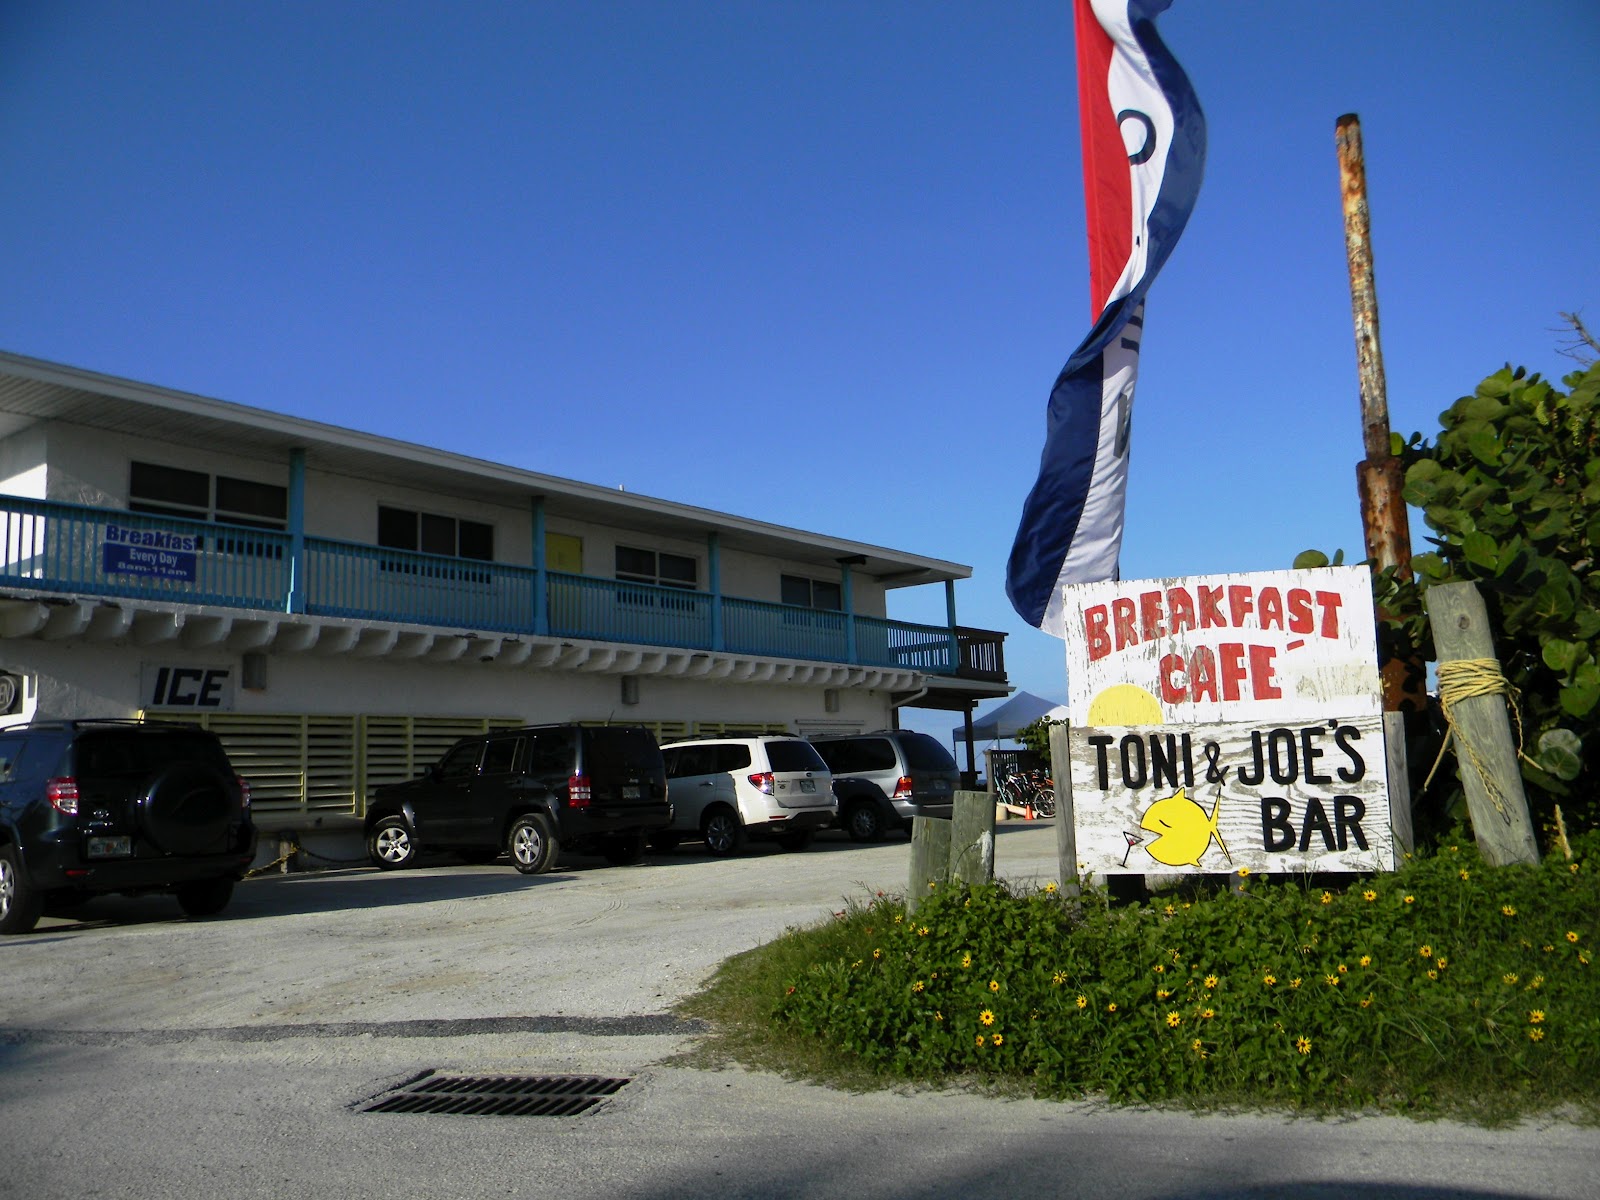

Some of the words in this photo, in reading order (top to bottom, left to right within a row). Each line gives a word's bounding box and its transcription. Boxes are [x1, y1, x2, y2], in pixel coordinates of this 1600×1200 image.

[106, 524, 198, 550] Breakfast
[117, 562, 187, 576] 8am-11am
[129, 548, 157, 565] Every
[160, 552, 178, 567] Day
[1084, 584, 1343, 662] BREAKFAST
[153, 667, 229, 706] ICE
[1088, 733, 1195, 790] TONI
[1204, 741, 1230, 787] &
[1237, 719, 1366, 786] JOE'S
[1261, 795, 1370, 852] BAR
